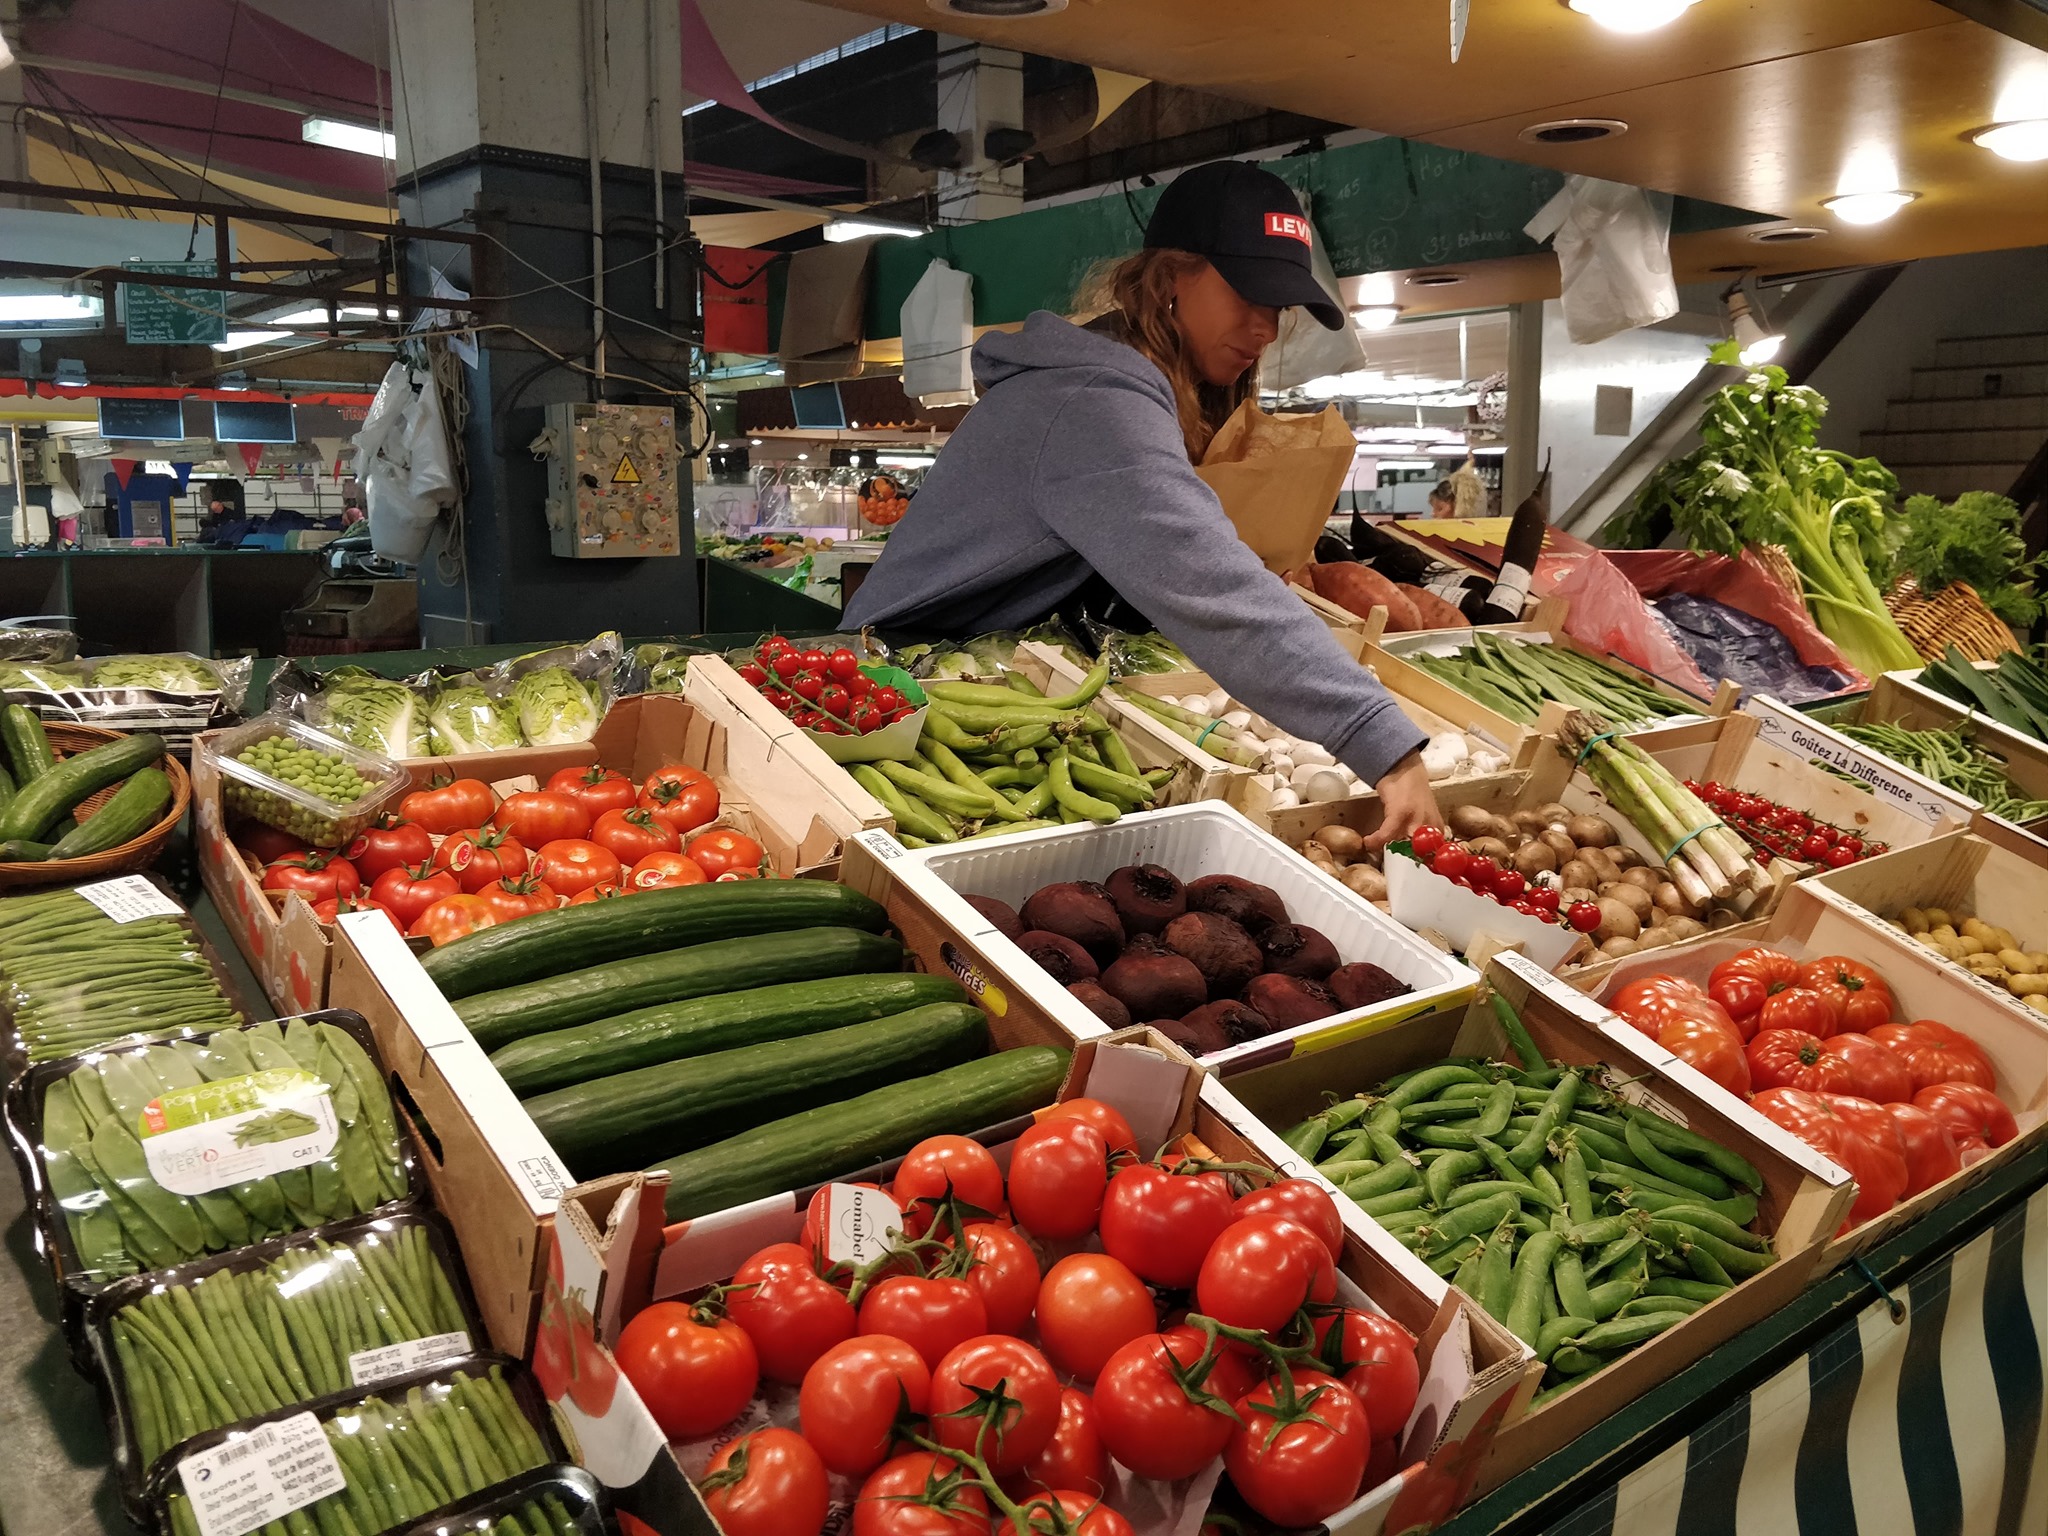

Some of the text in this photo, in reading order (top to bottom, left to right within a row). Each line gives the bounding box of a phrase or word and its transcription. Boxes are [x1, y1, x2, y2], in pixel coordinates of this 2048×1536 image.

[342, 406, 368, 421] TRA
[1791, 730, 1913, 802] Goûtez La Difference
[1830, 896, 1858, 911] Le
[292, 1147, 313, 1159] CAT
[852, 1191, 865, 1259] tomabel
